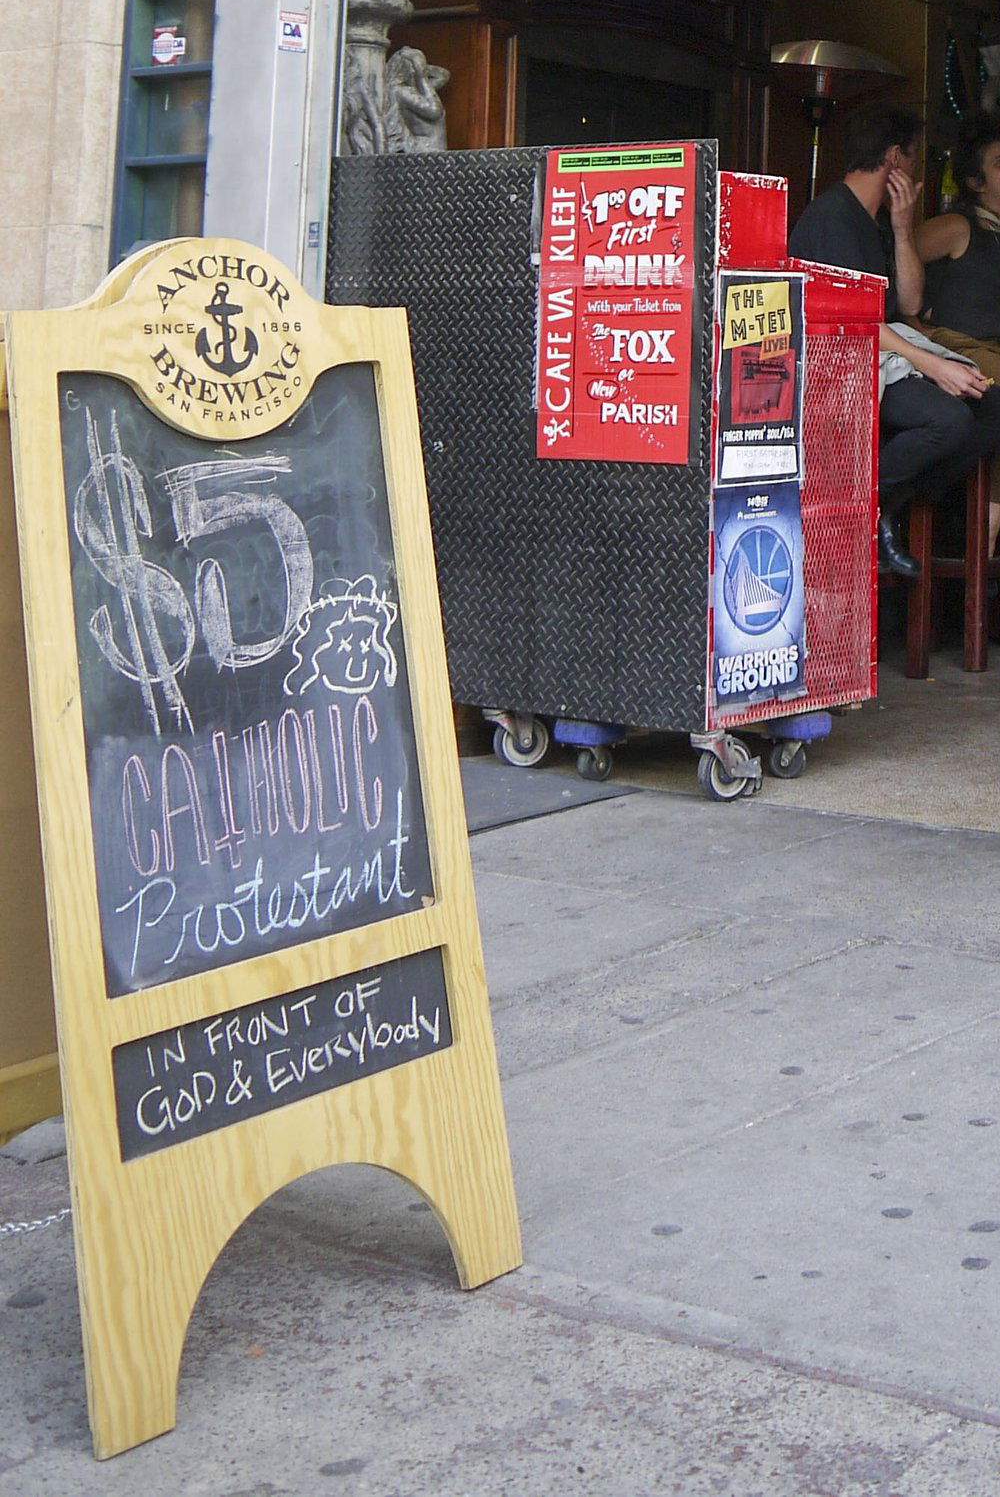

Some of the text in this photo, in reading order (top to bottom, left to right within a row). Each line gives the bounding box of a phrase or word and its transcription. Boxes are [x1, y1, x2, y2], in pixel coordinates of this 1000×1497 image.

[628, 184, 686, 218] OFF
[549, 186, 576, 262] KLEEF
[606, 218, 657, 251] First
[157, 255, 290, 314] ANCHOR
[584, 254, 686, 287] DRINK
[587, 298, 682, 315] With your Ticket from
[732, 289, 764, 311] THE
[144, 321, 302, 335] SINCE 1896
[731, 308, 786, 341] M-TET
[592, 323, 676, 364] The FOX
[763, 337, 788, 353] LIVE!
[150, 341, 301, 405] BREWING
[545, 331, 572, 412] CAFE
[589, 379, 618, 398] New
[618, 368, 636, 381] or
[155, 375, 302, 422] SAN FRANCISCO
[600, 402, 678, 426] PARISH
[74, 406, 314, 738] $5
[718, 644, 799, 675] WARRIORS
[716, 661, 799, 695] GROUND
[121, 694, 384, 878] CATHOLIC
[115, 787, 417, 976] Protestant
[147, 976, 382, 1079] IN FRONT OF
[225, 1058, 253, 1107] &
